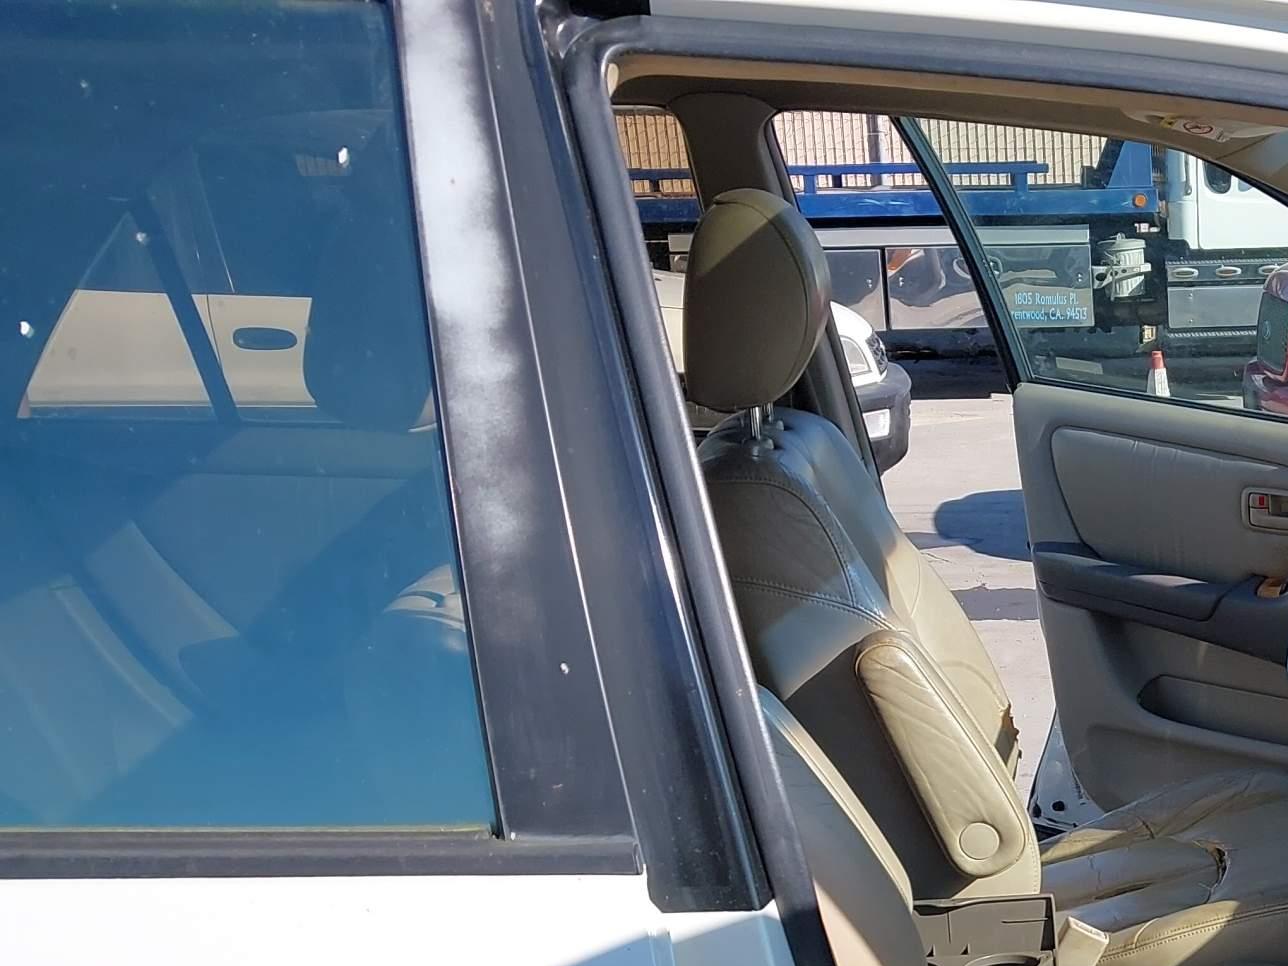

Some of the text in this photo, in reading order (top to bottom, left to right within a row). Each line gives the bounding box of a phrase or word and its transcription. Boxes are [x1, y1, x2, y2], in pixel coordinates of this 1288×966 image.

[1035, 292, 1068, 305] Romulus
[1010, 307, 1048, 321] rentwood,
[1066, 307, 1088, 320] 94513
